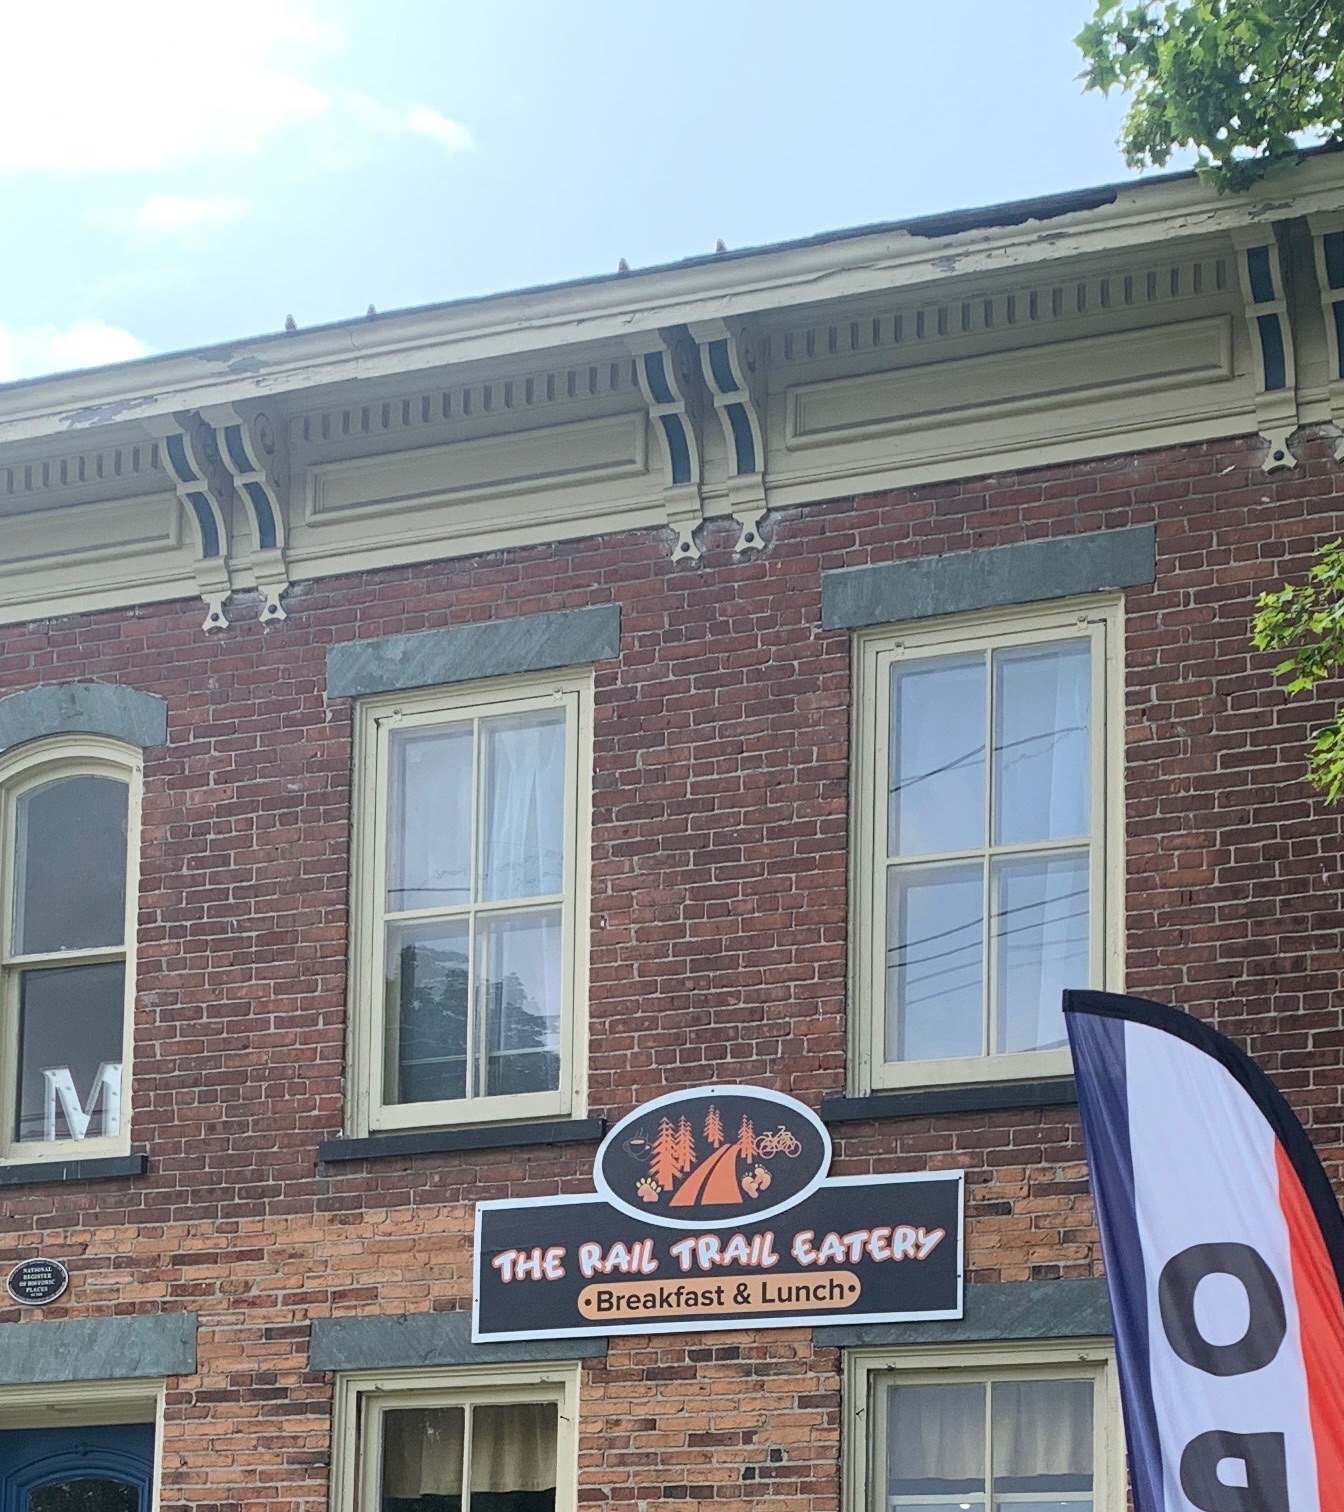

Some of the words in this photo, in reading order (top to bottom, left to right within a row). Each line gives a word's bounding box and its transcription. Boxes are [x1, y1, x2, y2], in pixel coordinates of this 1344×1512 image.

[40, 1061, 123, 1141] M
[492, 1246, 566, 1283] THE
[578, 1238, 658, 1279] RAIL
[670, 1230, 779, 1271] TRAIL
[791, 1225, 946, 1266] EATERY
[596, 1285, 725, 1313] Breakfast
[732, 1282, 752, 1305] &
[761, 1278, 845, 1304] Lunch
